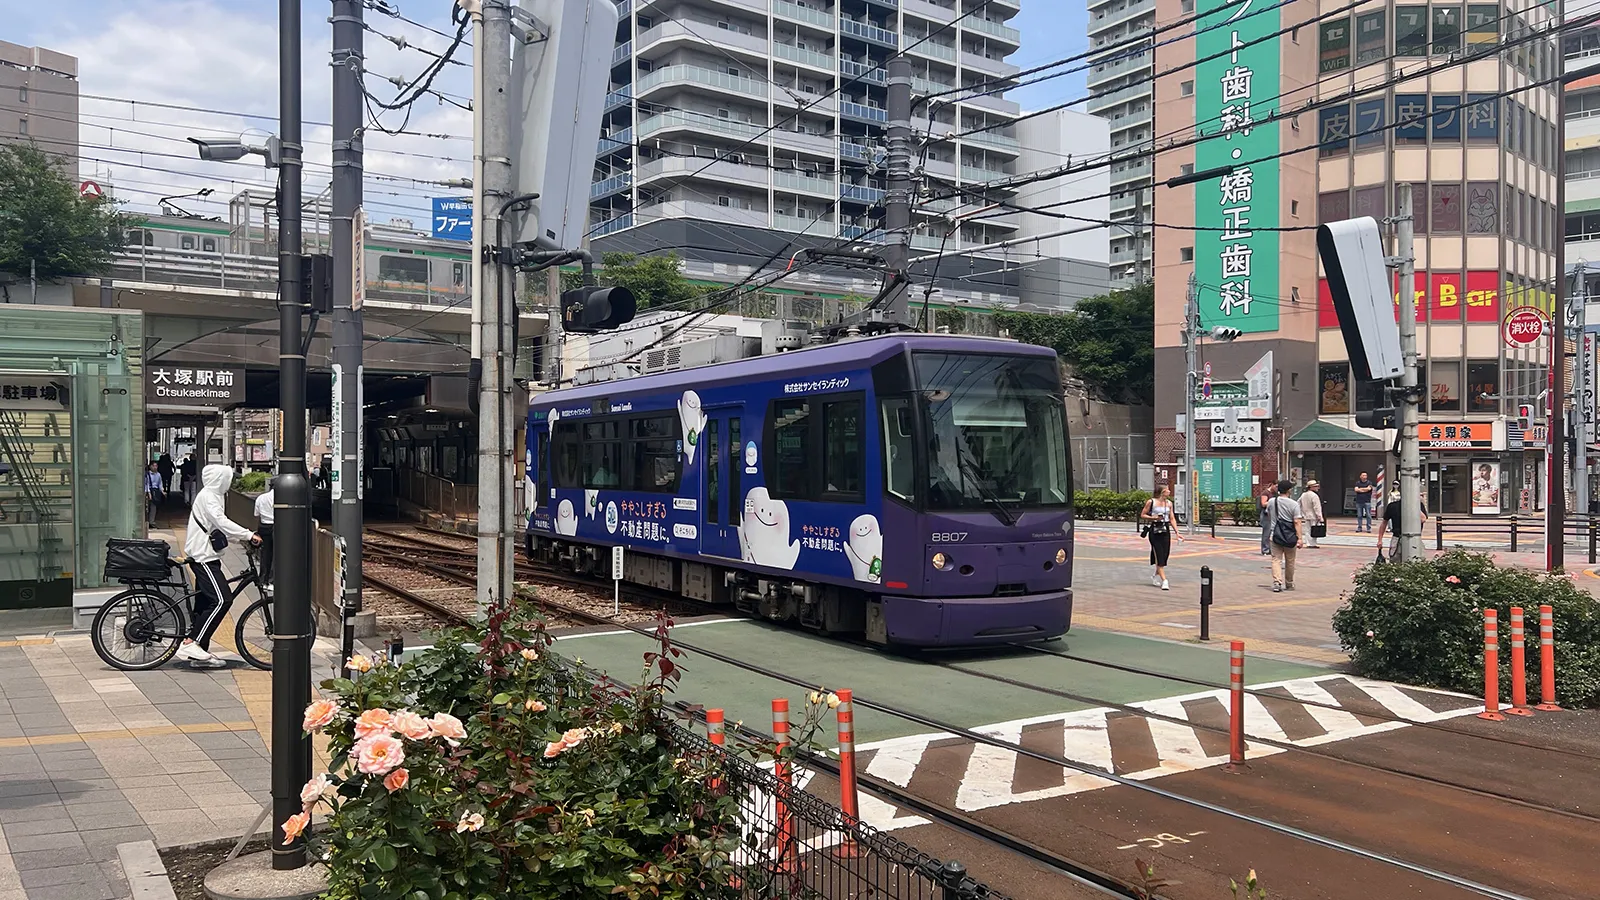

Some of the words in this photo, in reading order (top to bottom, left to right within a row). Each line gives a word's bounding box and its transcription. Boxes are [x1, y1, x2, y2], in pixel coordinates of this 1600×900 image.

[436, 216, 473, 232] ファー
[1511, 321, 1540, 335] 消火栓
[152, 368, 234, 387] 大塚駅前
[0, 384, 57, 401] 駐車場
[156, 385, 230, 398] Ōtsukaekimae
[784, 377, 849, 394] 株式会社サンセイランディック
[1430, 426, 1471, 439] 吉野家
[621, 499, 667, 519] ややこしすぎる
[620, 520, 670, 543] 不動産問題に。
[802, 524, 840, 538] ややこしすぎる
[931, 532, 968, 542] 8807
[801, 537, 843, 552] 不動産問題に。
